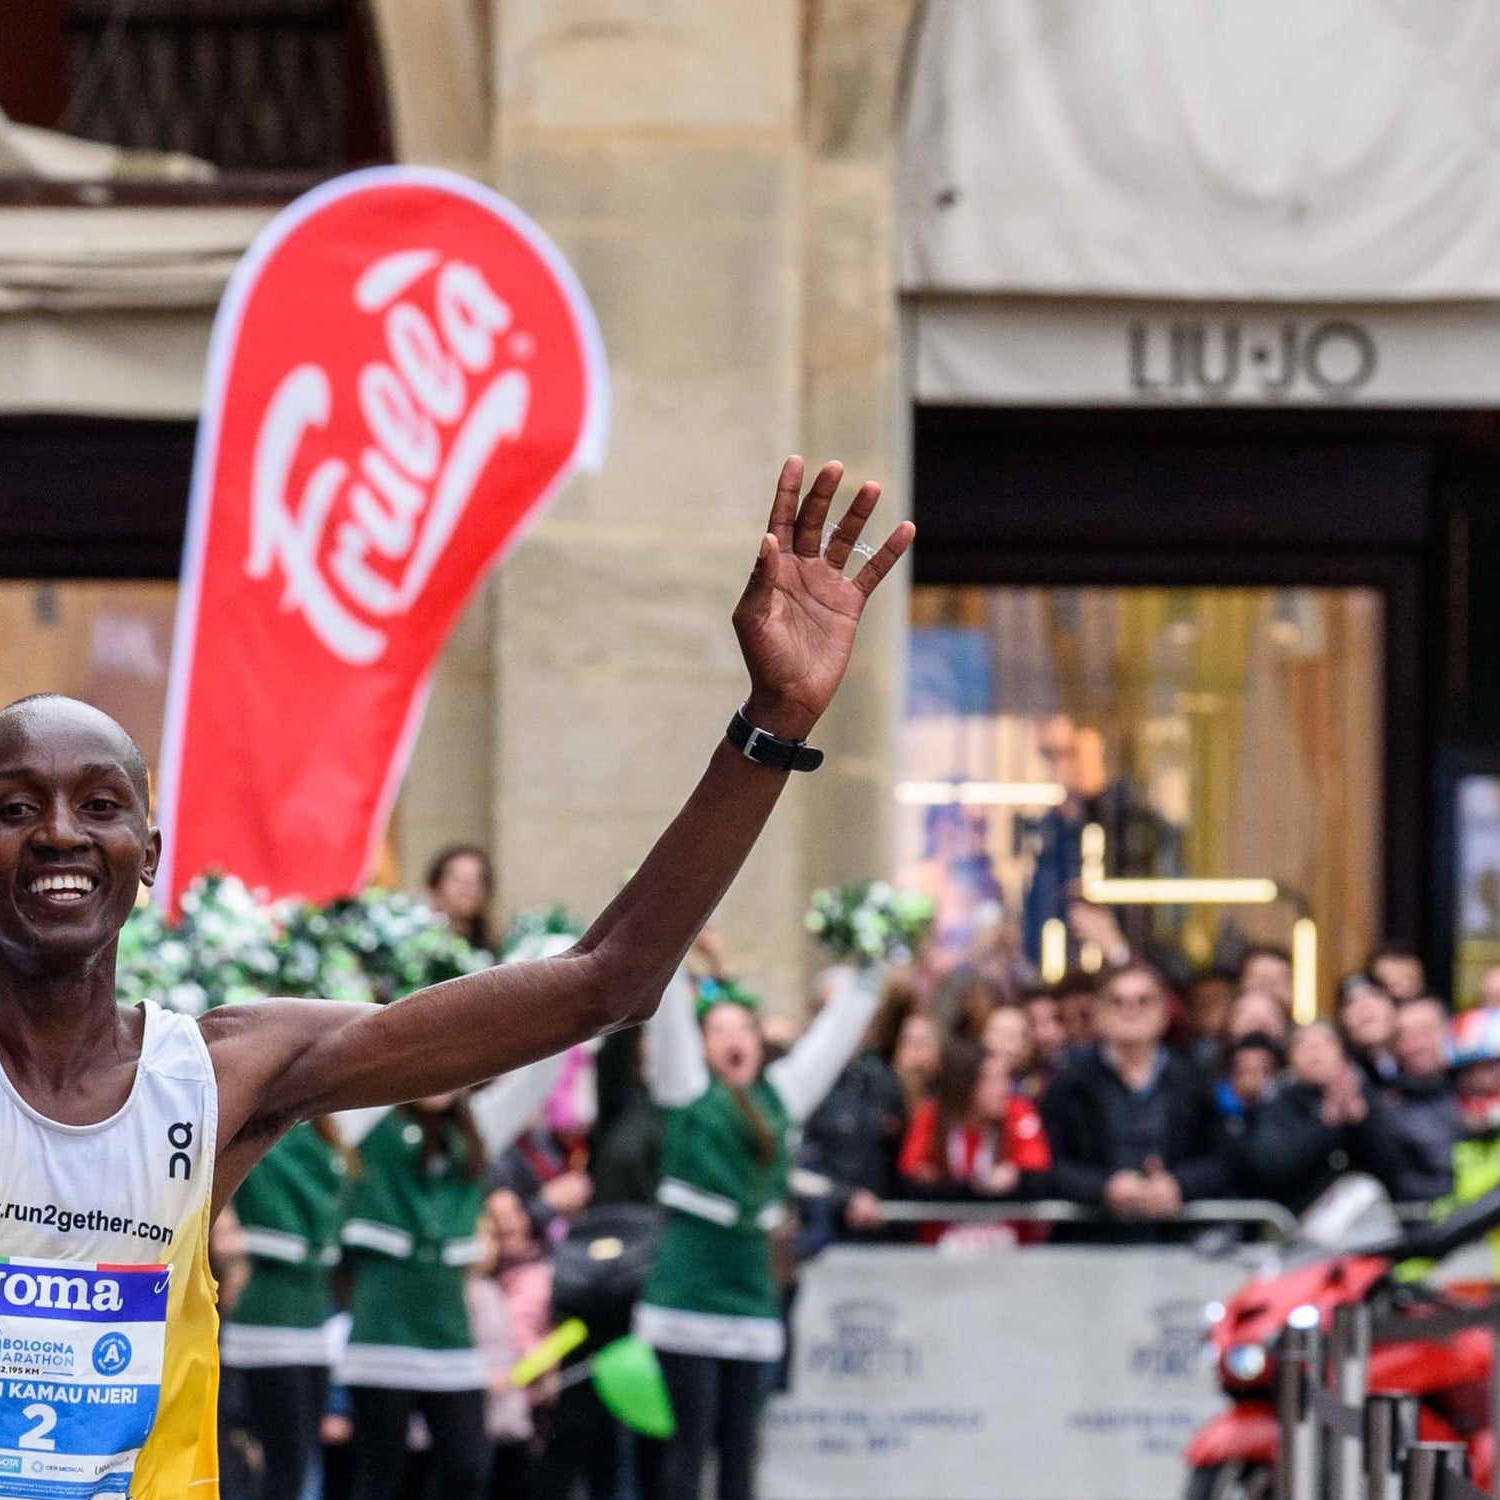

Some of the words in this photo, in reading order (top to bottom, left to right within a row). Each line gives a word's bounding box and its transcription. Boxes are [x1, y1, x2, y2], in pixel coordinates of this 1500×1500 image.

[3, 1338, 75, 1354] BOLOGNA
[24, 1367, 40, 1376] KM
[8, 1382, 82, 1404] KAMAU
[87, 1387, 138, 1405] NJERI
[18, 1403, 58, 1451] 2
